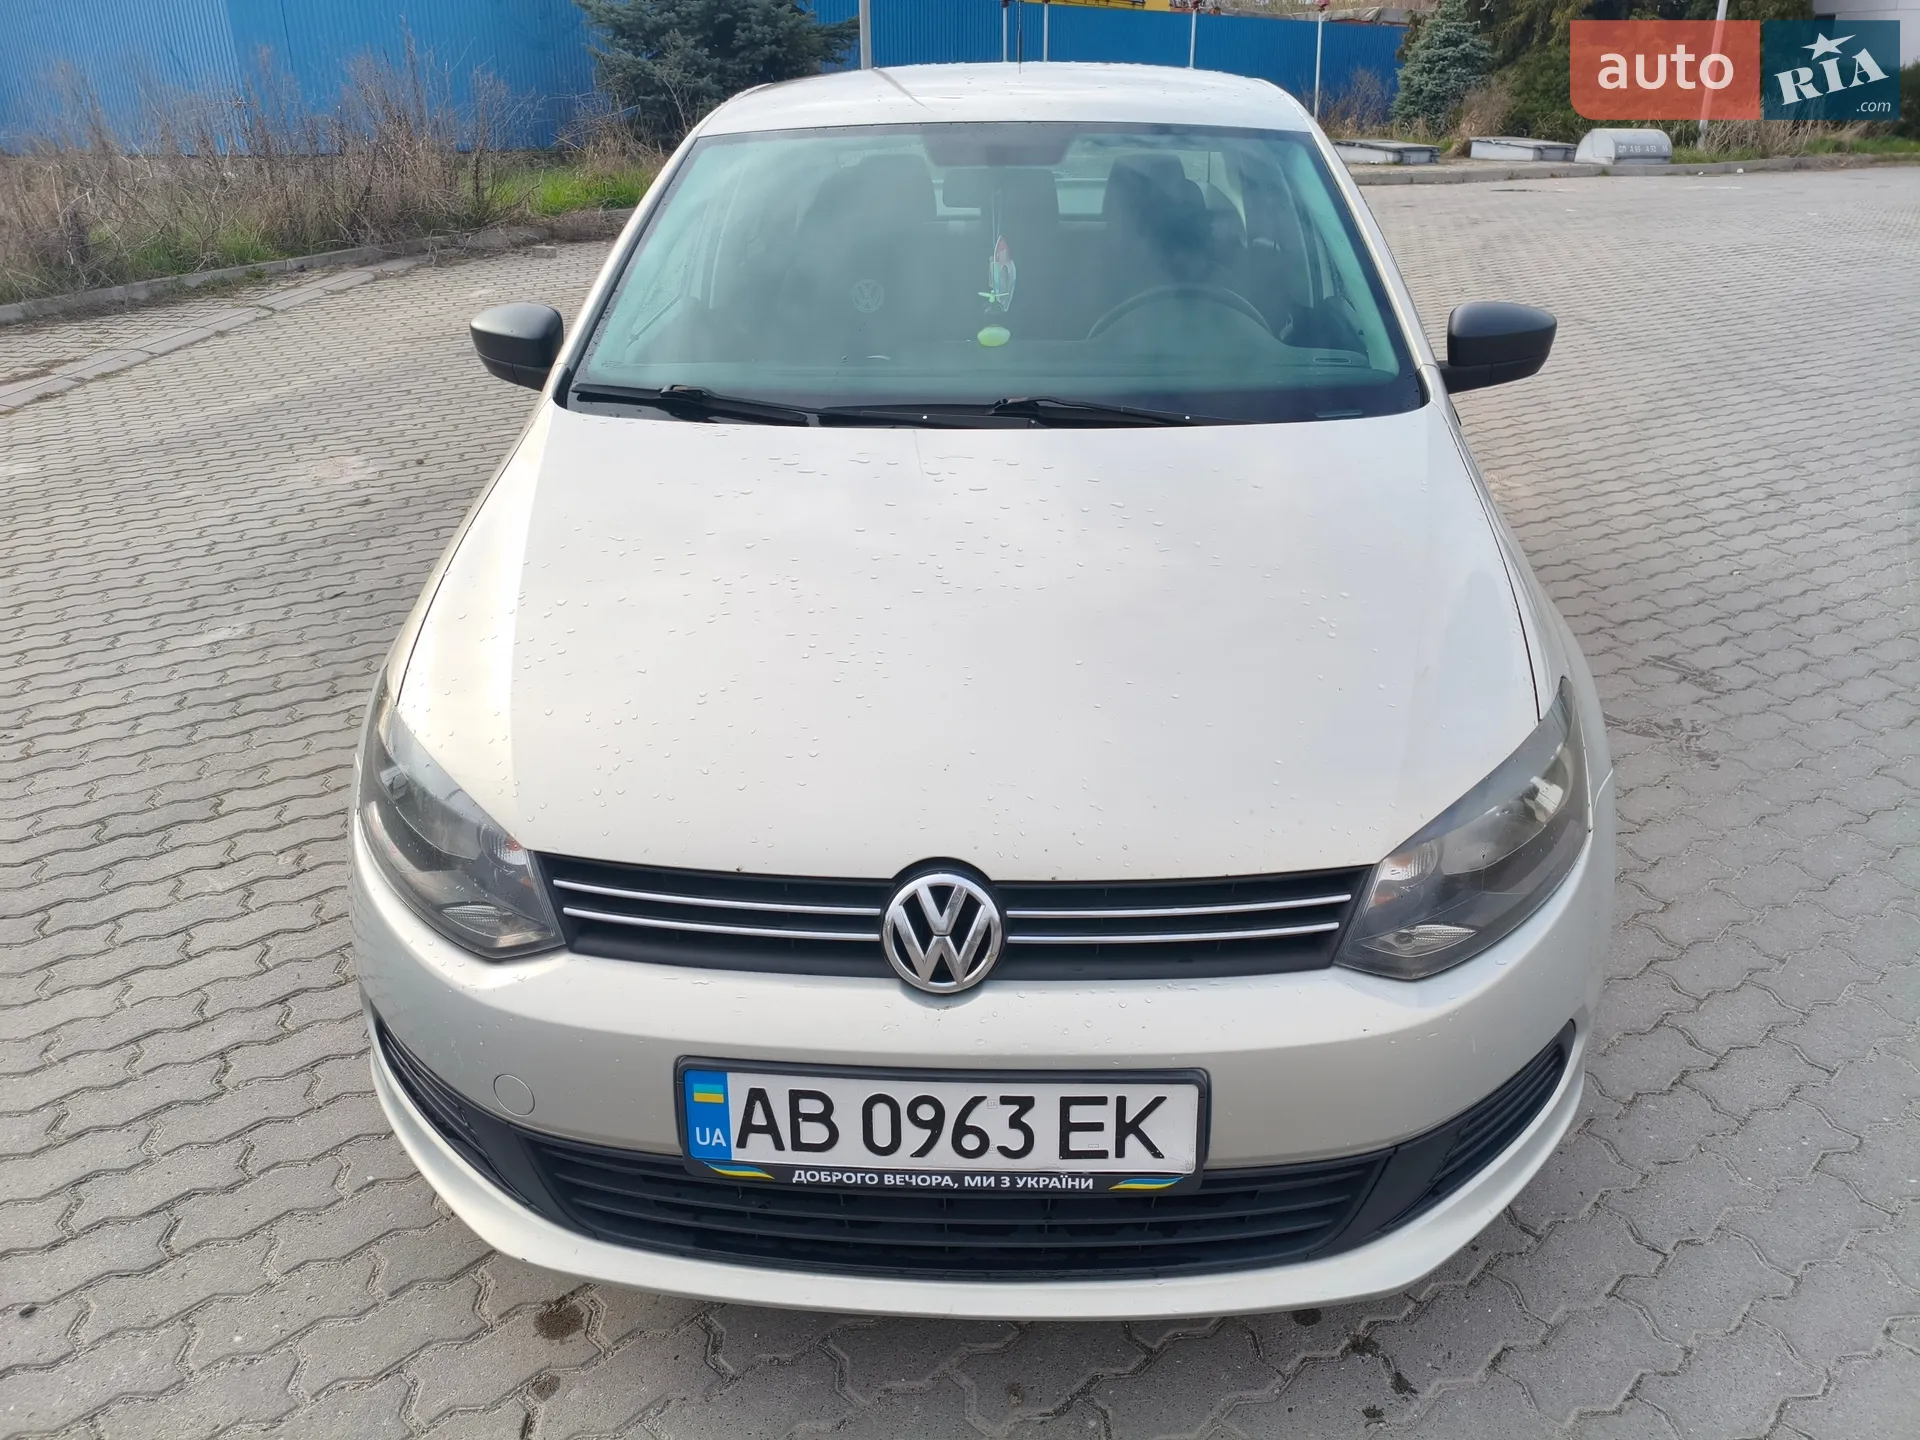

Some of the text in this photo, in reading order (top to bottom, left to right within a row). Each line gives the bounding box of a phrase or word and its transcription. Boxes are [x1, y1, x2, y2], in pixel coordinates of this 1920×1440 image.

[736, 1087, 1168, 1159] AB 0963 EK
[695, 1127, 726, 1147] UA
[792, 1170, 879, 1185] ДОБРОГО
[883, 1173, 959, 1188] ВЕЧОРА,
[964, 1175, 995, 1188] МИ
[1016, 1174, 1094, 1189] УКРАЇНИ
